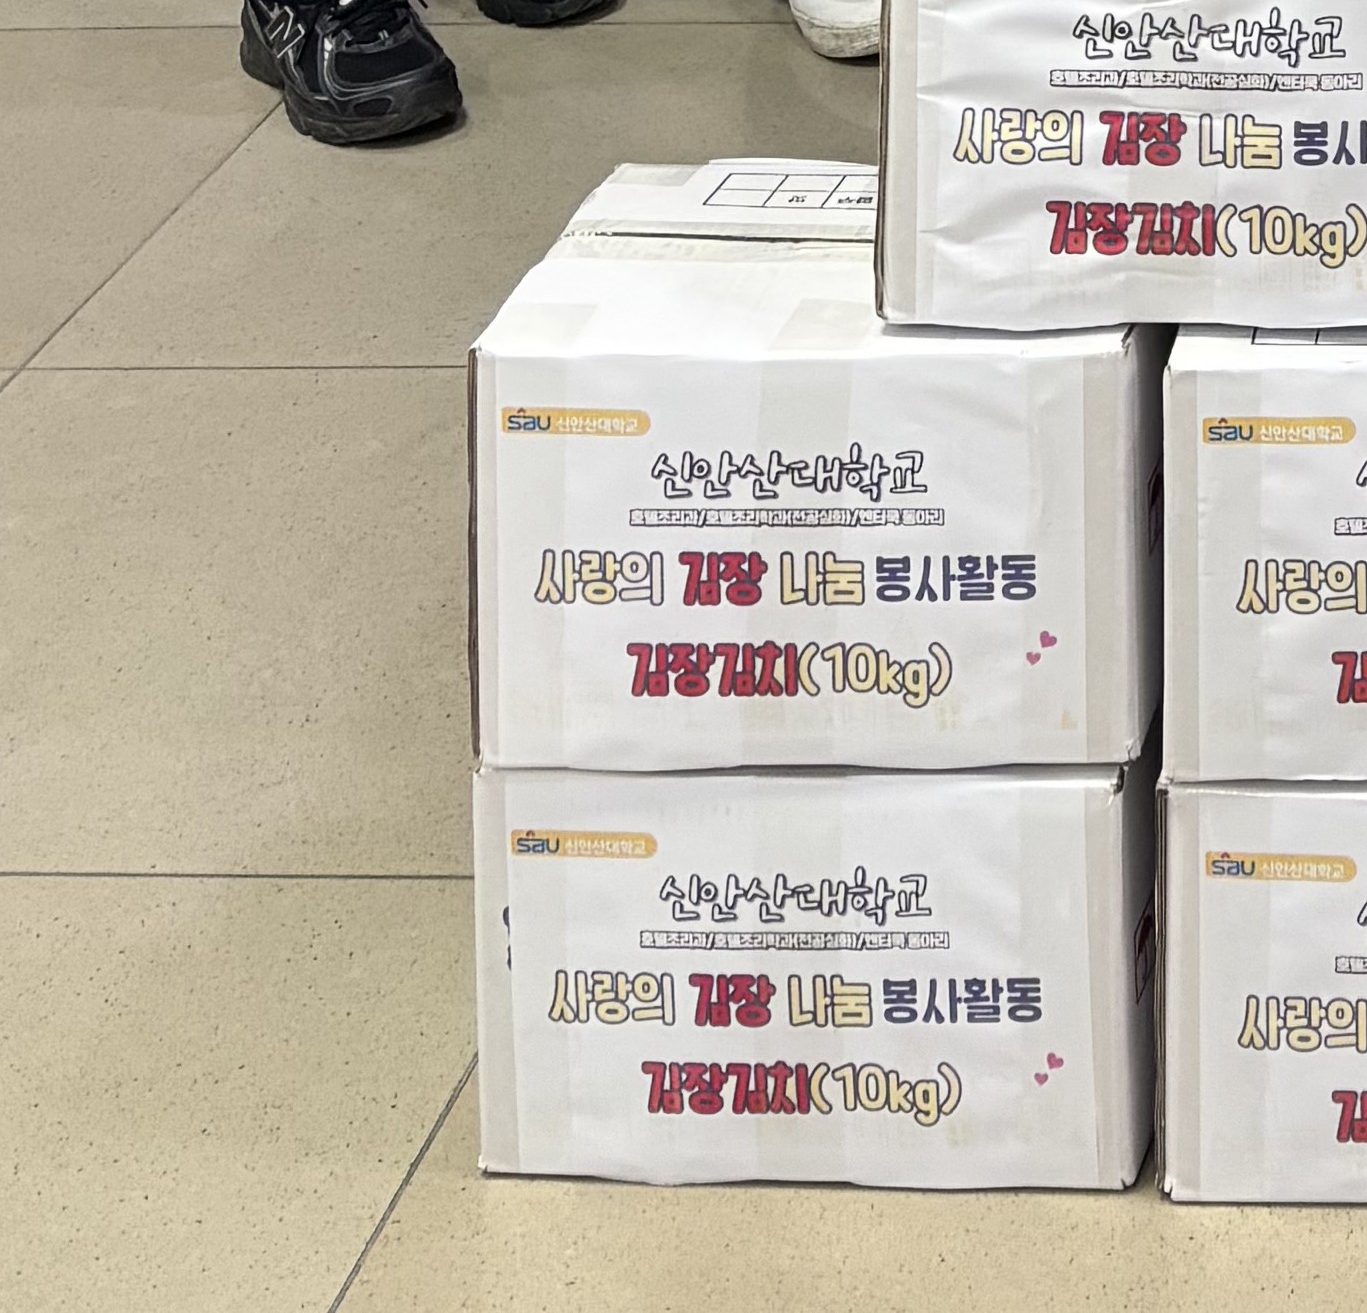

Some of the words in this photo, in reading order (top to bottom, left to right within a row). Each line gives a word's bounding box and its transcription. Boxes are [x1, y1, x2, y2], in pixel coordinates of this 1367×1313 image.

[1072, 5, 1347, 66] 신안산대학교
[954, 109, 1083, 165] 사랑의
[1097, 111, 1186, 167] 김장
[1198, 113, 1283, 168] 나눔
[628, 640, 953, 709] 김장김치(10kg)
[642, 1059, 963, 1128] 김장김치(10kg)
